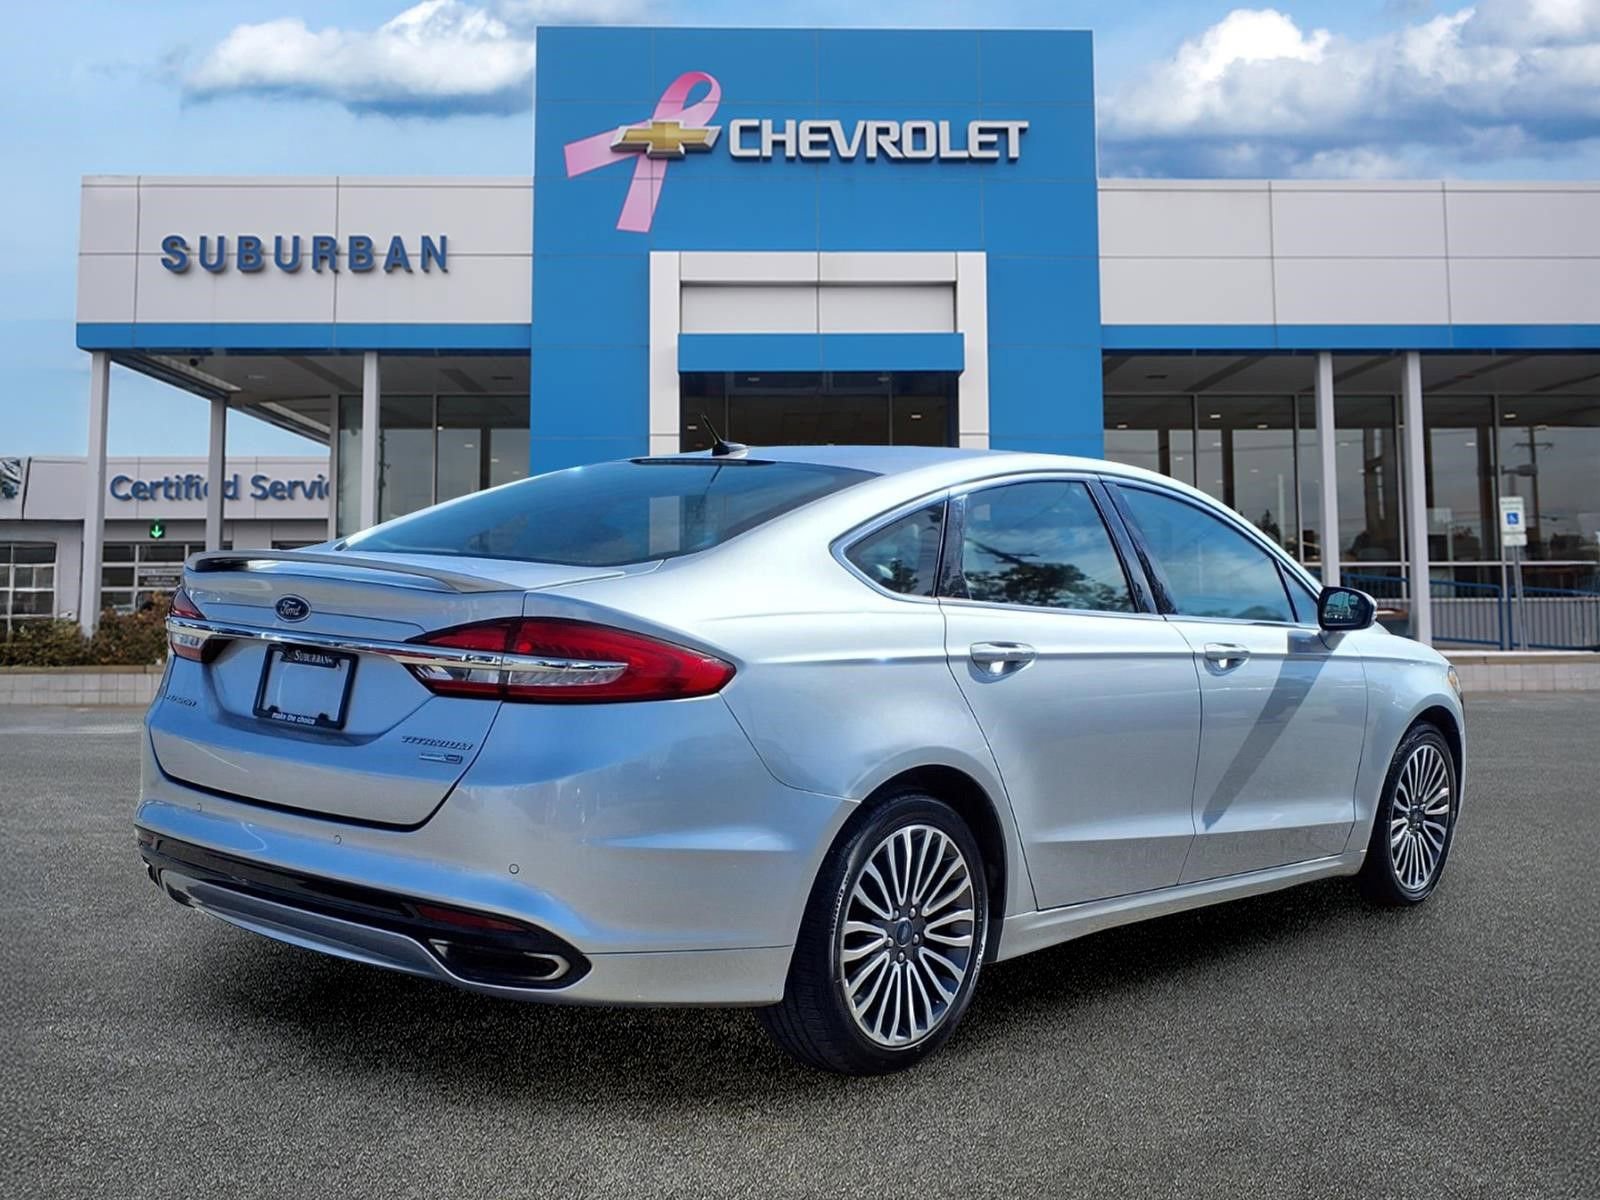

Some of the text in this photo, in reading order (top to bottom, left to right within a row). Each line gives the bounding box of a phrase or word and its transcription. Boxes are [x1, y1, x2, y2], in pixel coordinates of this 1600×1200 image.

[729, 119, 1029, 159] CHEVROLET
[161, 235, 449, 273] SUBURBAN
[110, 474, 239, 500] Certifid
[401, 736, 473, 750] TITANIUM
